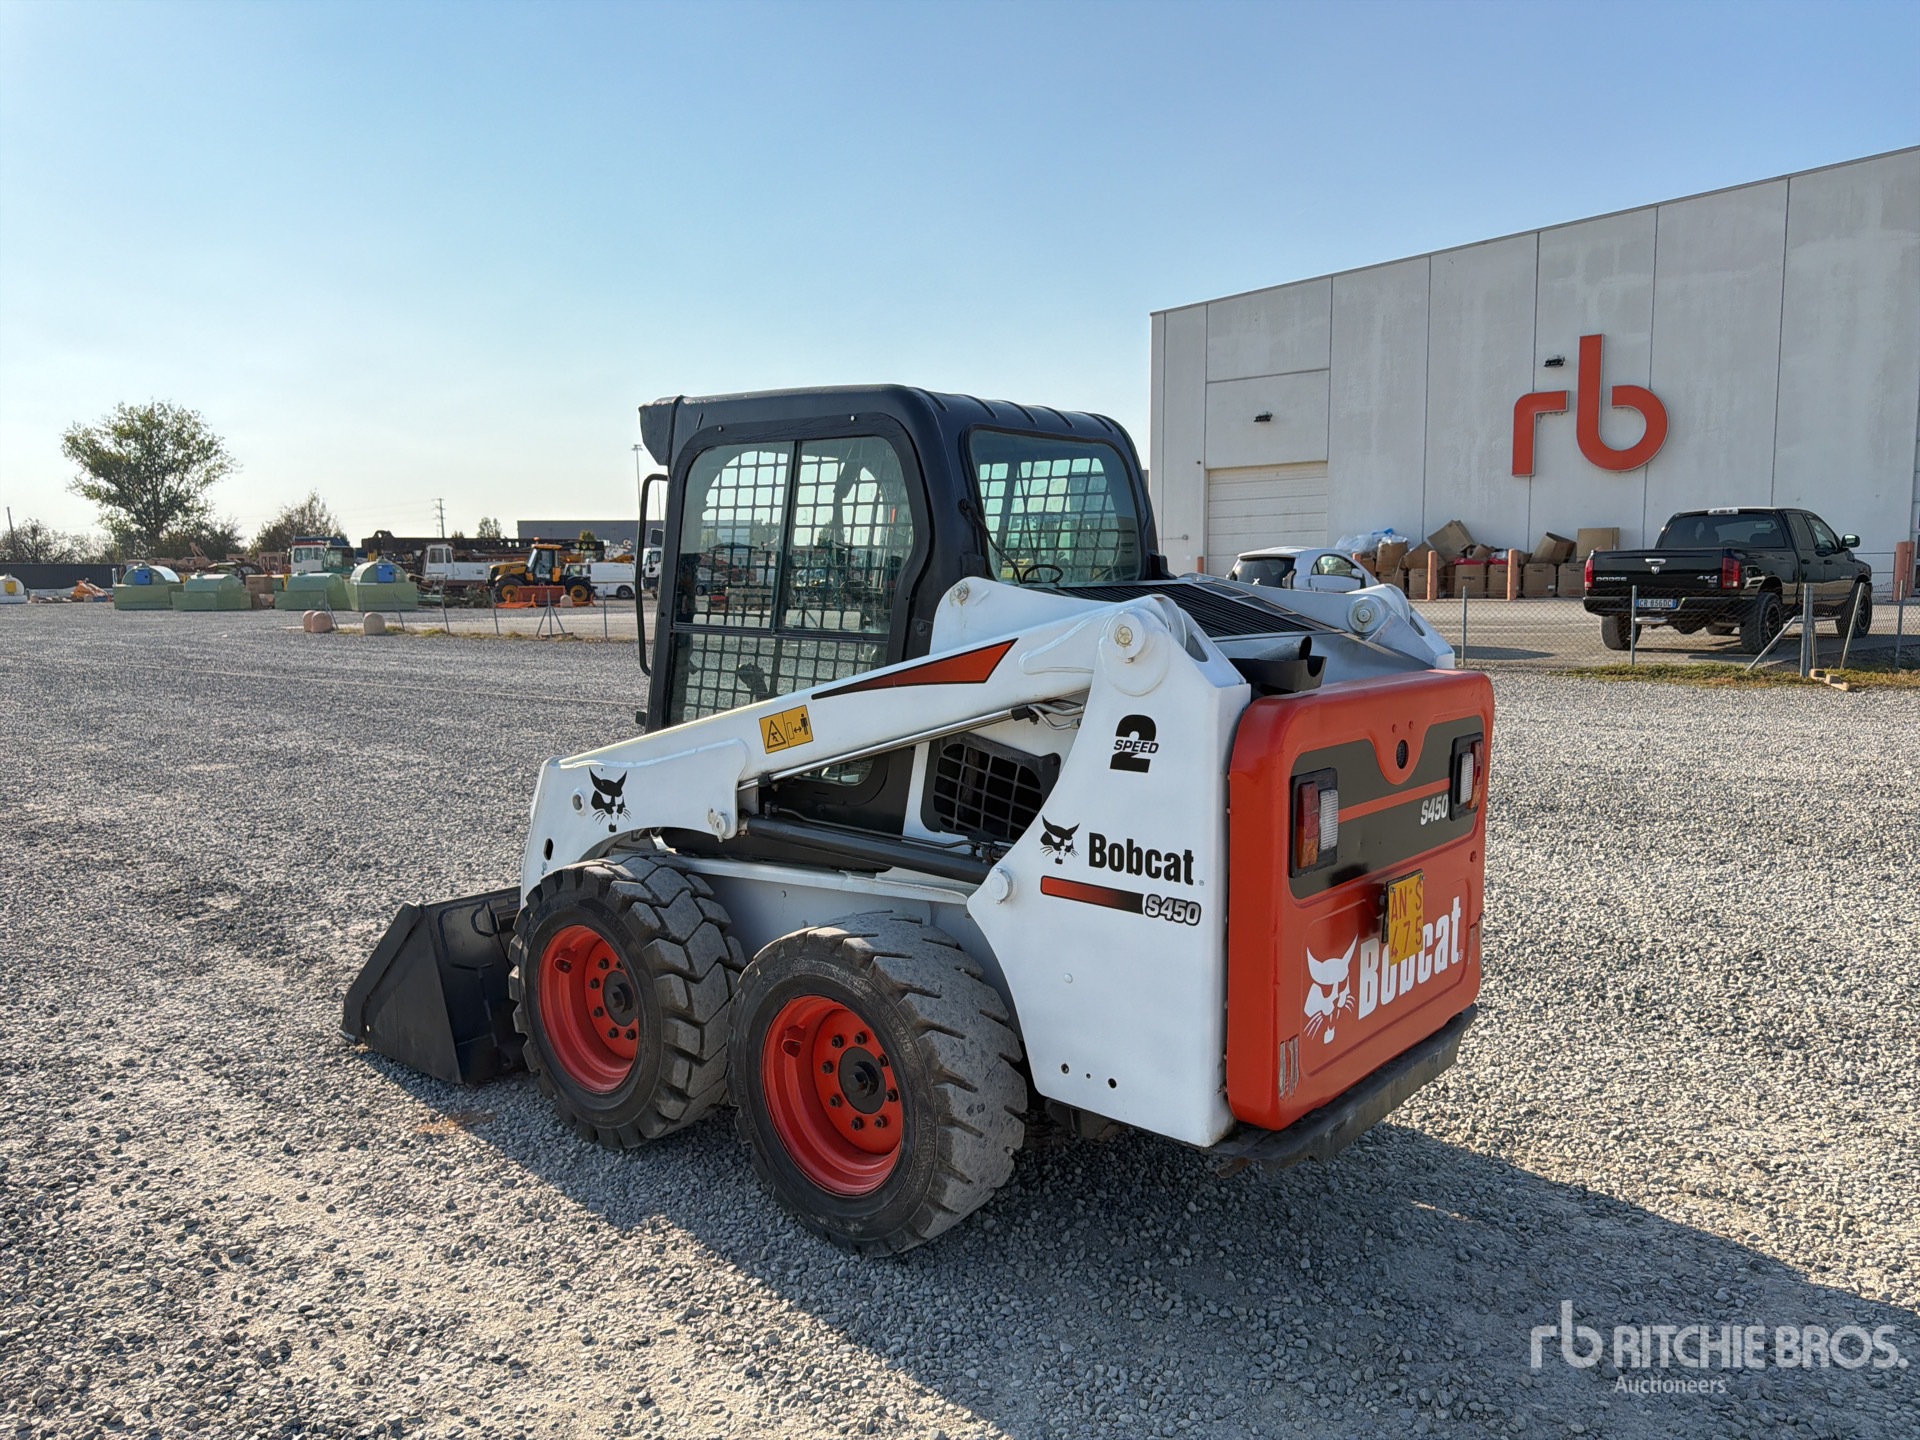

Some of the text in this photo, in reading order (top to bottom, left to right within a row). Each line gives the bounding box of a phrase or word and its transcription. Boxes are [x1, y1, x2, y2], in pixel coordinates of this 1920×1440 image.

[1512, 333, 1669, 476] rb
[1110, 713, 1157, 773] 2
[1113, 739, 1159, 754] SPEED
[1420, 794, 1449, 826] S450
[1089, 832, 1194, 886] Bobcat
[1145, 894, 1201, 926] S450
[1391, 915, 1422, 958] 475
